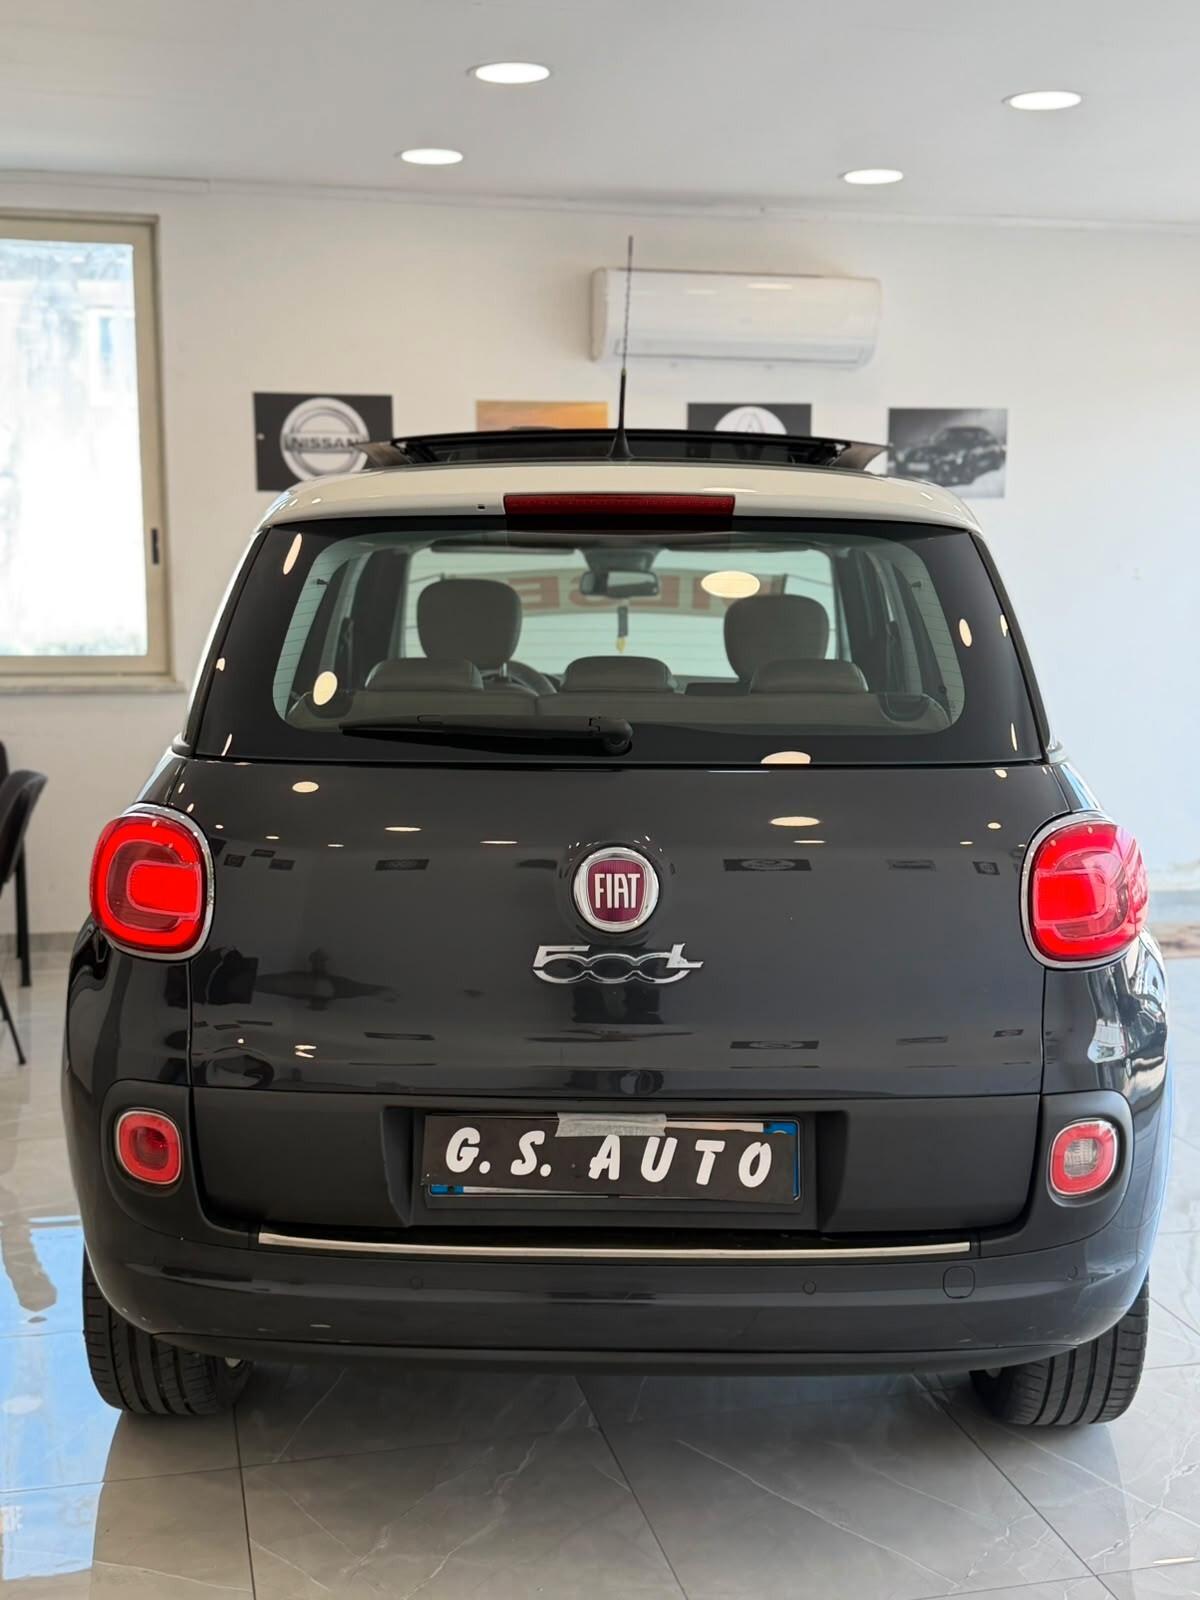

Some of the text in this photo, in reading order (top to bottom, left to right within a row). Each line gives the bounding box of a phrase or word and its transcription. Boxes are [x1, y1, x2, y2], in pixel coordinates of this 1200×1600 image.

[291, 436, 360, 449] NISSAN
[594, 873, 641, 909] FIAT
[588, 1134, 772, 1188] AUTO
